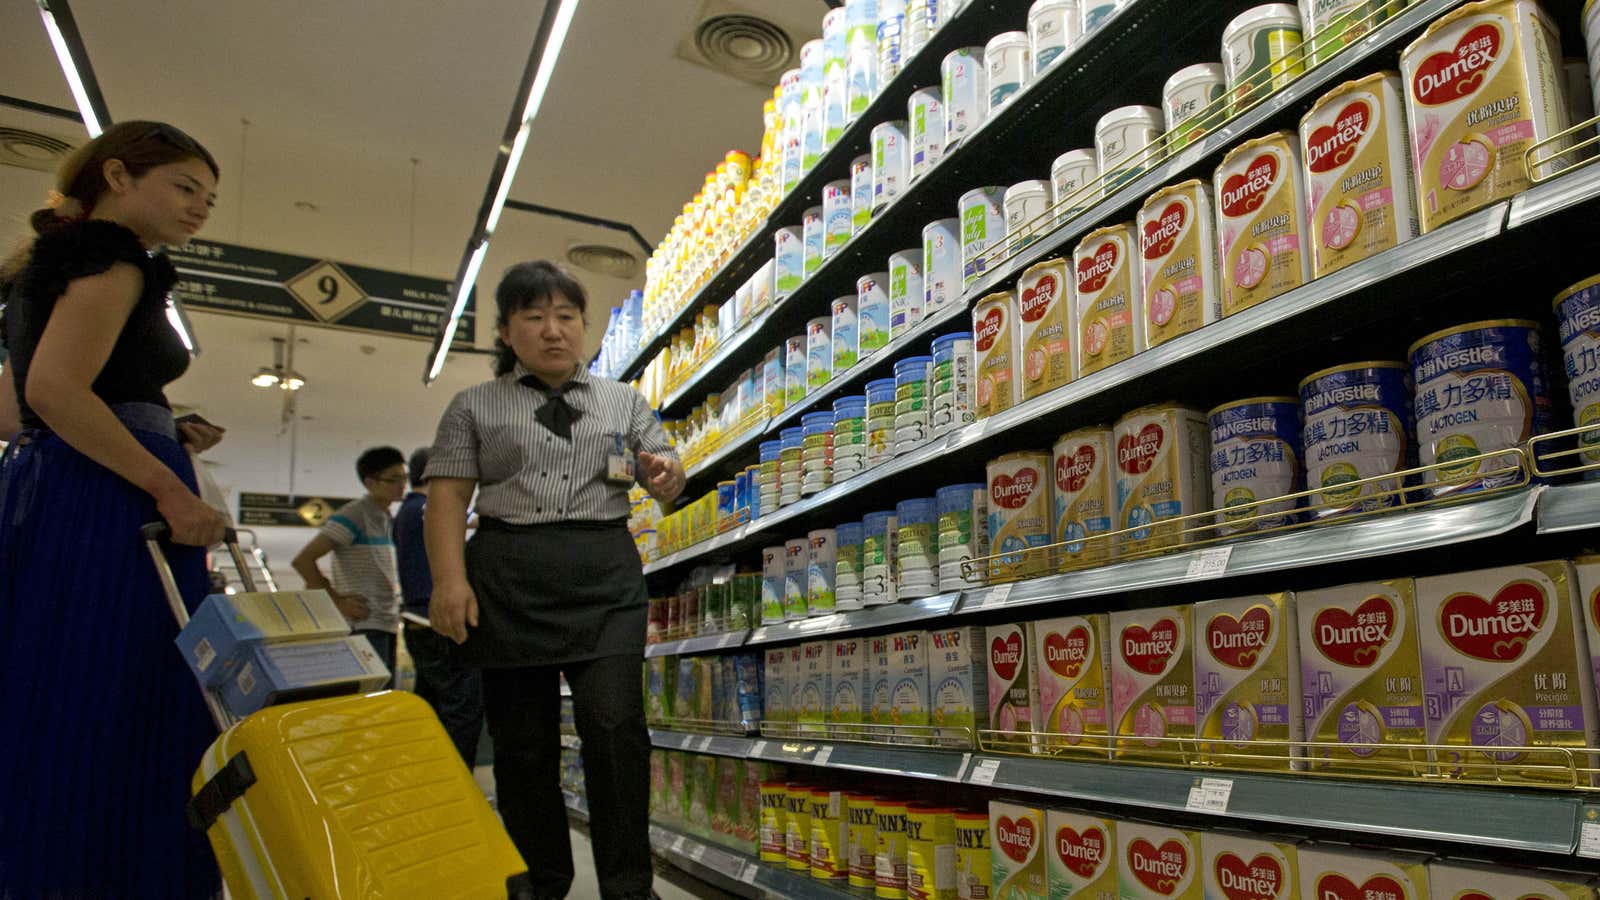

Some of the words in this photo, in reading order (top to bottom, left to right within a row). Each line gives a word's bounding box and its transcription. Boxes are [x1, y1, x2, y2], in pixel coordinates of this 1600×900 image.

[1458, 35, 1492, 57] 多美滋
[956, 65, 964, 78] 2
[1418, 45, 1496, 98] Dumex
[930, 101, 937, 113] 2
[1466, 95, 1520, 128] 优阶贝护
[1336, 111, 1364, 132] 多美滋
[888, 136, 896, 148] 2
[1308, 120, 1366, 166] Dumex
[1223, 173, 1274, 209] Dumex
[991, 203, 1000, 216] 3
[1426, 190, 1437, 214] 1
[935, 236, 944, 249] 3
[1142, 219, 1182, 250] Dumex
[911, 264, 920, 275] 3
[1076, 260, 1112, 285] Dumex
[317, 275, 338, 305] 9
[941, 403, 952, 426] 3
[1430, 409, 1479, 434] LACTOGEN
[911, 421, 924, 442] 3
[1120, 442, 1158, 463] Dumex
[1318, 442, 1360, 460] LACTOGEN
[852, 453, 863, 472] 3
[1058, 461, 1092, 480] Dumex
[1221, 468, 1257, 485] LACTOGEN
[994, 481, 1033, 499] Dumex
[874, 574, 885, 596] 3
[1496, 599, 1535, 614] 多美滋
[1357, 611, 1387, 625] 多美滋
[1449, 612, 1542, 638] Dumex
[894, 634, 919, 651] HiPP
[932, 631, 961, 649] HiPP
[1213, 630, 1267, 649] Dumex
[1321, 624, 1391, 646] Dumex
[791, 648, 800, 663] Hi
[836, 642, 857, 657] HiPP
[993, 650, 1019, 664] Dumex
[1048, 646, 1086, 661] Dumex
[1126, 640, 1174, 656] Dumex
[1450, 671, 1461, 691] A
[956, 828, 986, 849] NNY
[999, 826, 1032, 848] Dumex
[1061, 839, 1102, 864] Dumex
[1134, 853, 1184, 879] Dumex
[1222, 867, 1278, 898] Dumex
